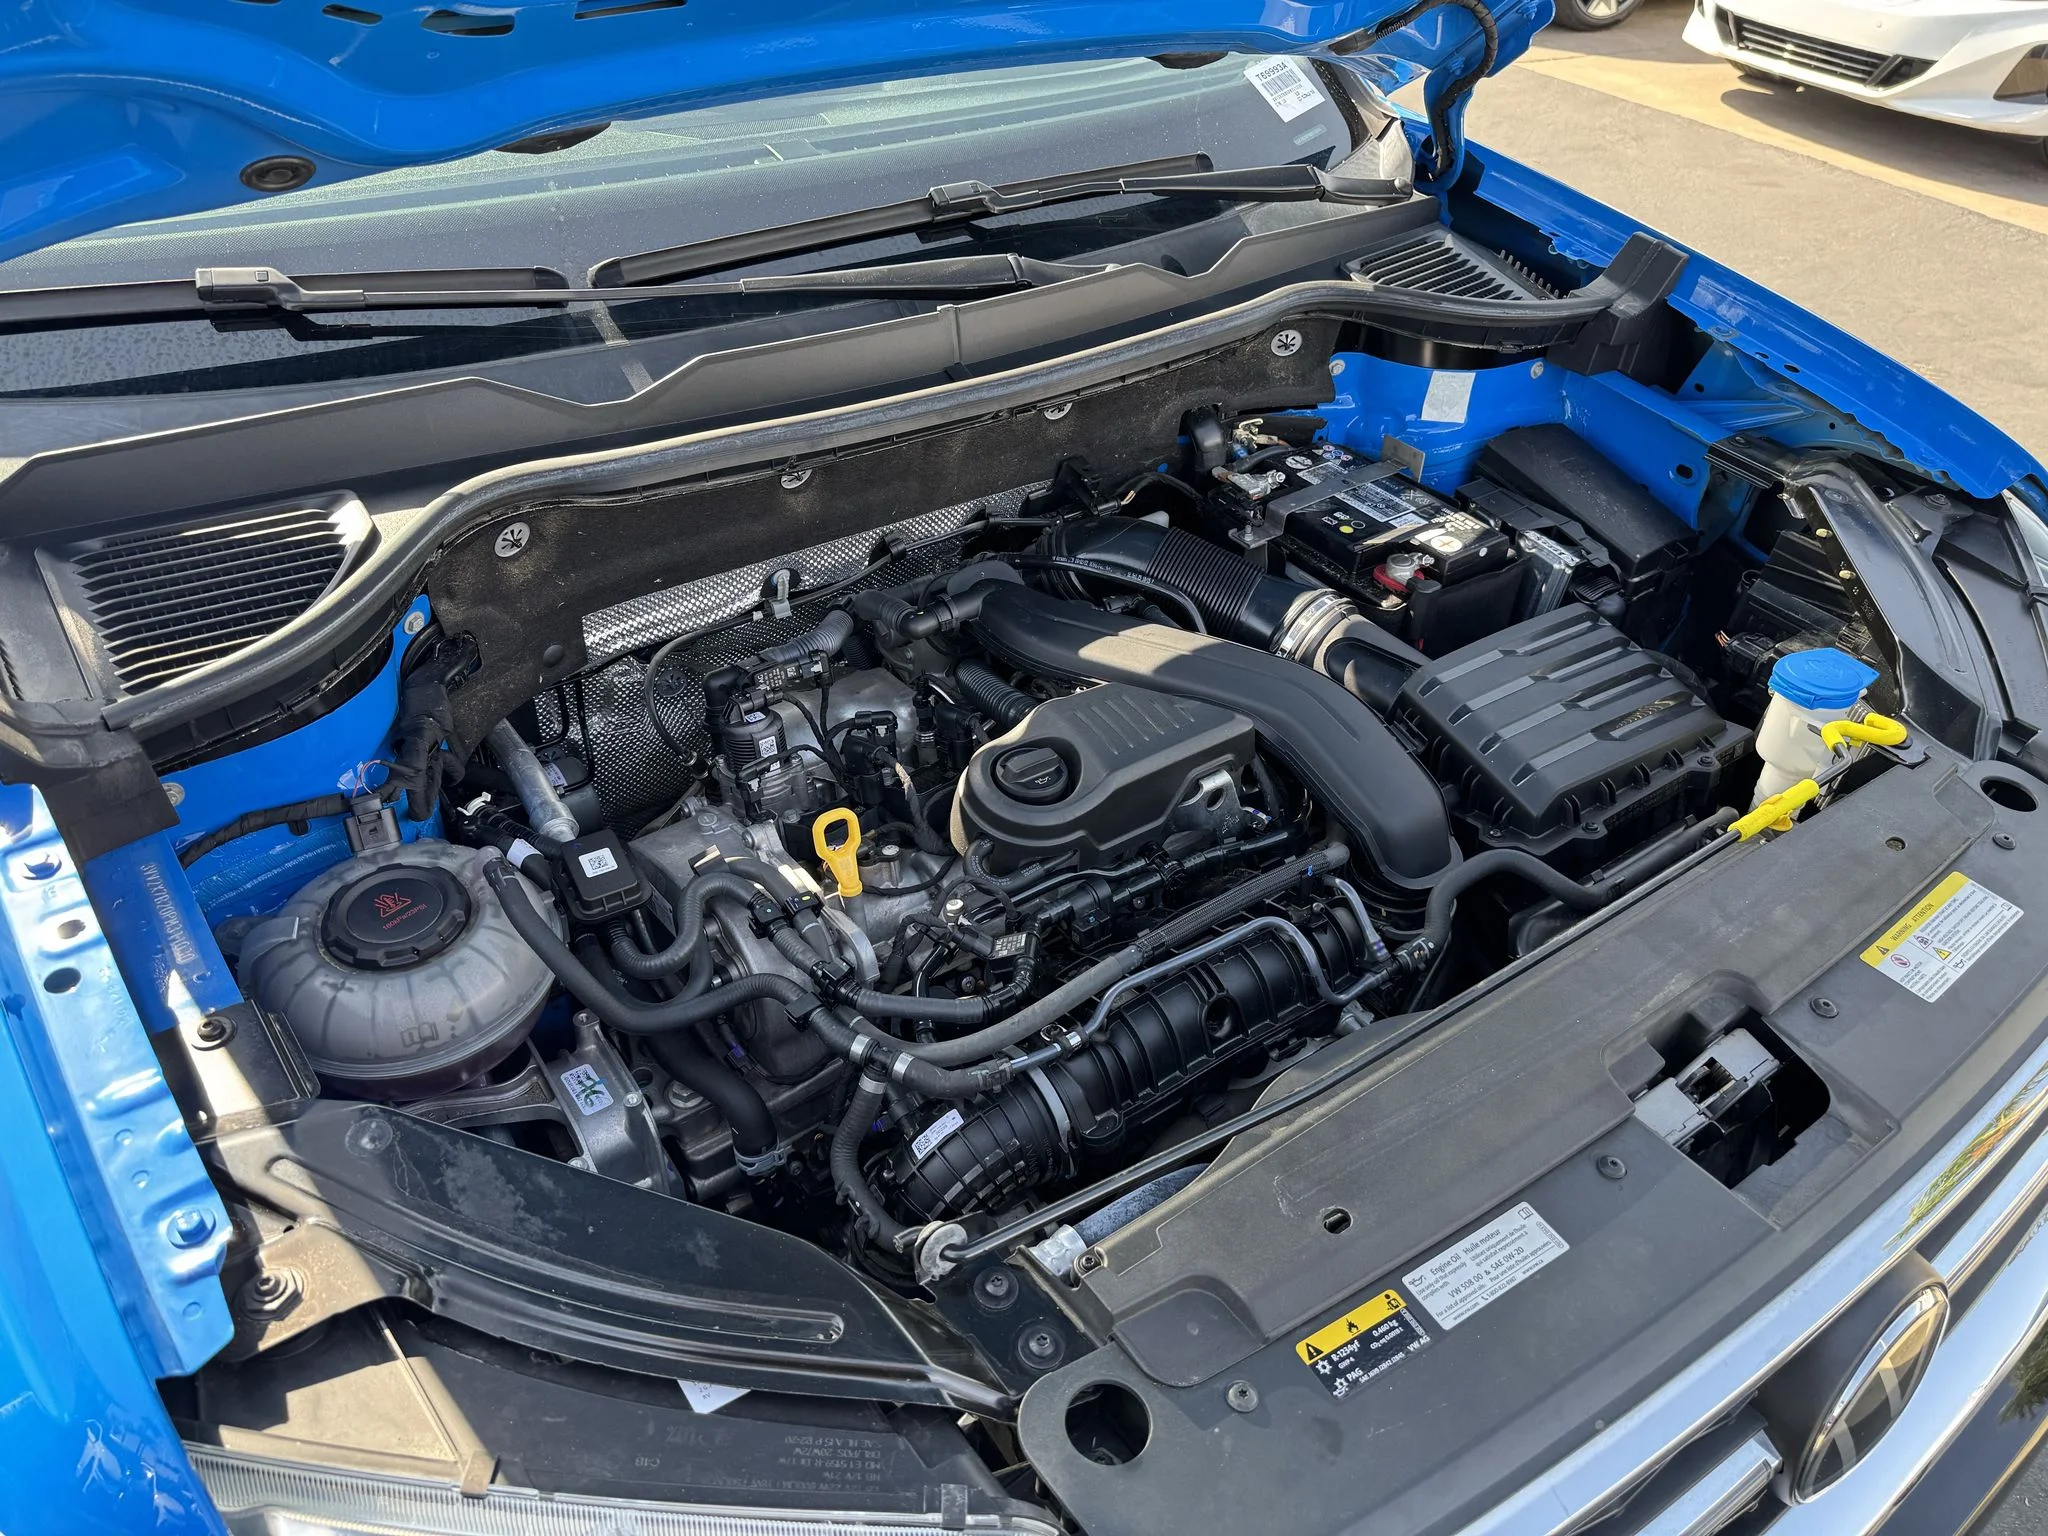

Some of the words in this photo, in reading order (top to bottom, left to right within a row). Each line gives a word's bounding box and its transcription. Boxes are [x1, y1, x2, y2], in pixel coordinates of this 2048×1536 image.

[1890, 922, 1911, 940] WARNING
[1911, 902, 1933, 922] ATTENTION
[1462, 1241, 1480, 1254] Huile
[1478, 1228, 1501, 1244] moteur
[1429, 1259, 1453, 1276] Engine
[1449, 1252, 1461, 1263] Oil
[1447, 1286, 1462, 1298] VW
[1460, 1278, 1474, 1290] 508
[1472, 1272, 1484, 1282] 00
[1490, 1259, 1505, 1271] SAE
[1502, 1246, 1524, 1263] 0W-20
[1371, 1323, 1389, 1336] 0.460
[1387, 1318, 1398, 1328] kg
[1330, 1339, 1362, 1363] R-1234yf
[1406, 1340, 1421, 1351] VW
[1418, 1334, 1430, 1344] AG
[1346, 1367, 1363, 1381] PAG
